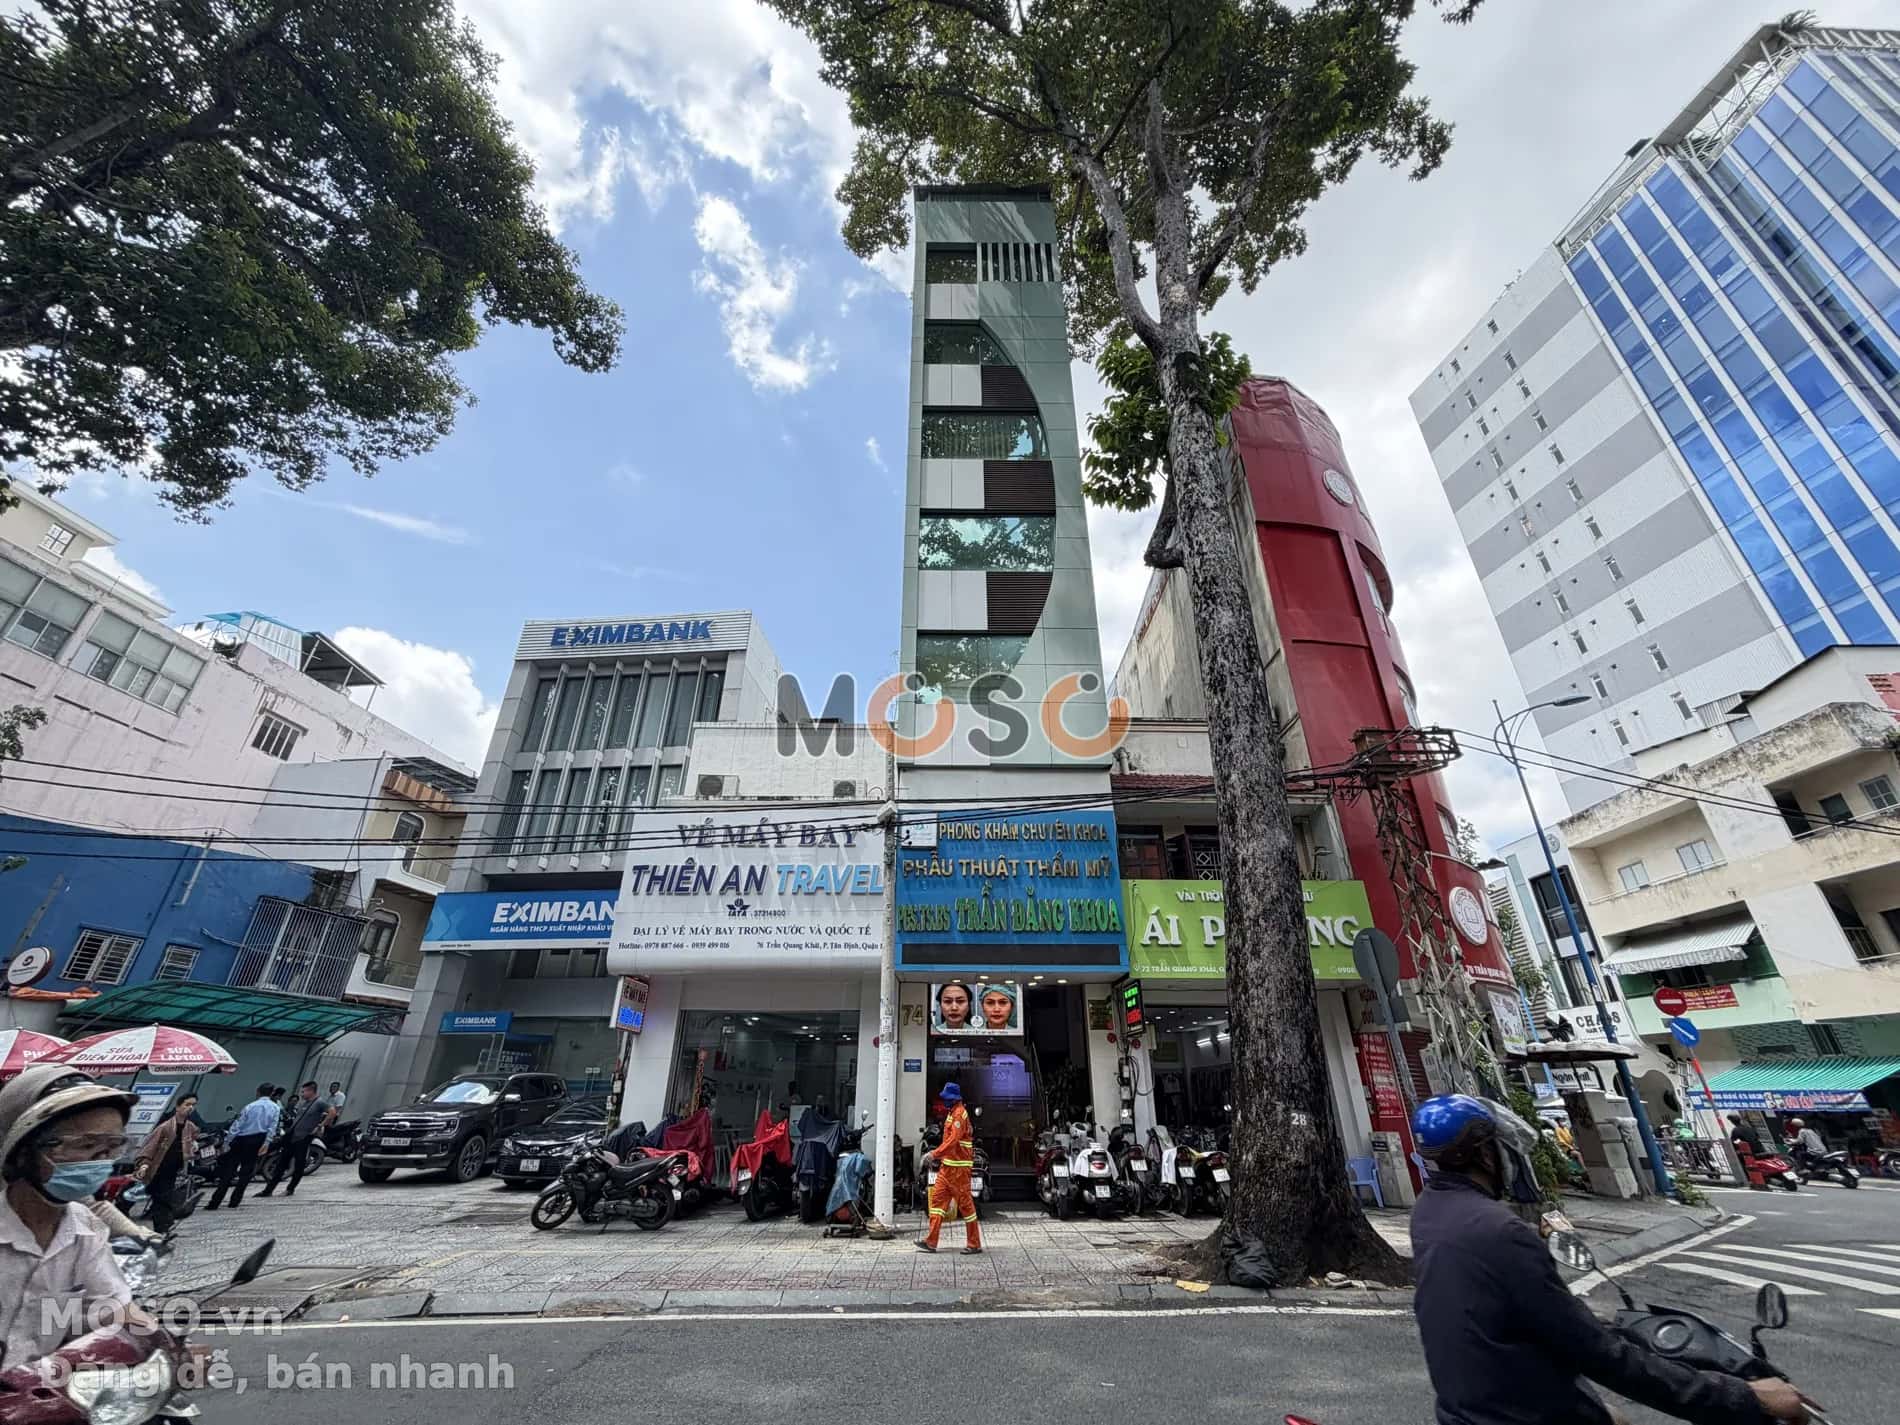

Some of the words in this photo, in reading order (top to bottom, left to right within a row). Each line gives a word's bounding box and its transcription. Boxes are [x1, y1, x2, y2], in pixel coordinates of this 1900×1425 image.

[551, 620, 713, 647] EXIMBANK
[721, 817, 792, 848] MÁY
[799, 824, 858, 848] BAY
[632, 857, 718, 896] THIÊN
[719, 865, 768, 896] AN
[777, 865, 884, 896] TRAVEL
[903, 851, 952, 877] PHẪU
[959, 855, 1019, 879] THUẬT
[491, 901, 615, 923] EXIMBAN
[1069, 897, 1121, 931] KHOA
[633, 926, 651, 937] ĐẠI
[690, 924, 712, 936] MÁY
[715, 926, 735, 936] BAY
[738, 926, 772, 936] TRONG
[825, 923, 854, 937] QUỐC
[1141, 908, 1181, 946] ÁI
[783, 942, 803, 950] Quang
[455, 1016, 497, 1025] EXIMBANK
[902, 1005, 923, 1026] 74
